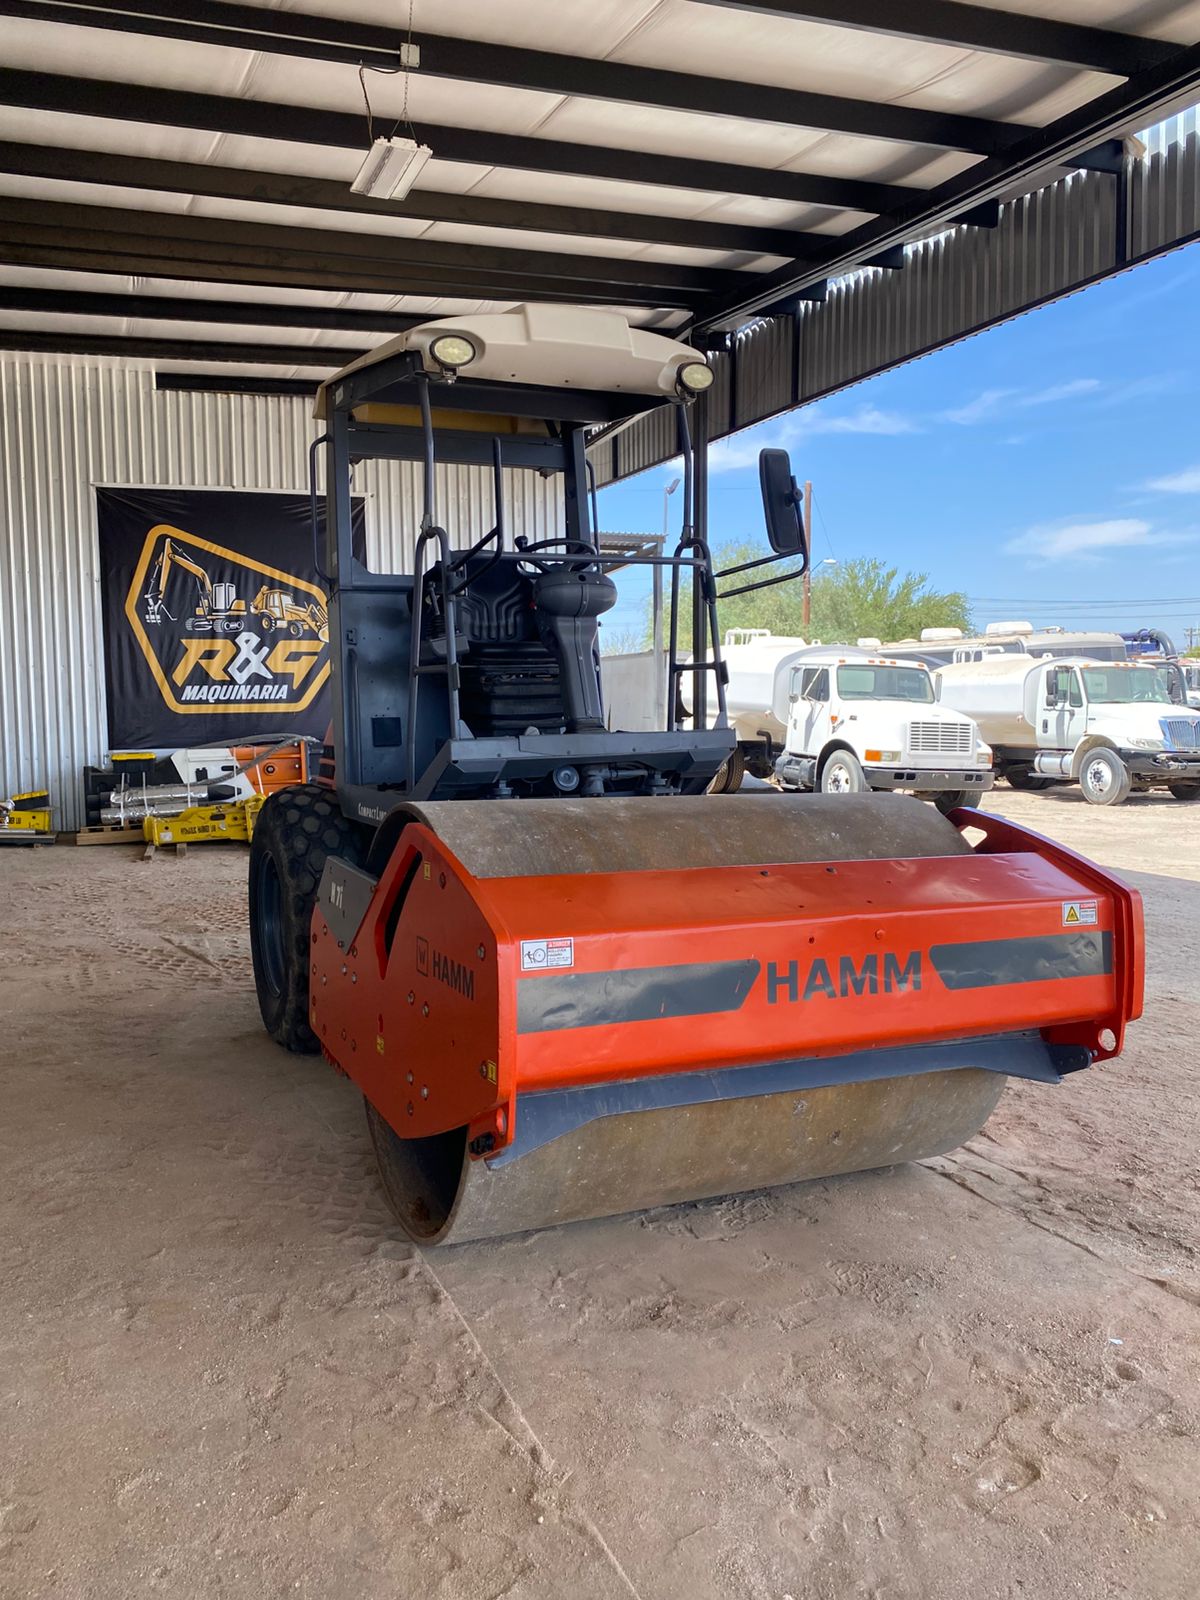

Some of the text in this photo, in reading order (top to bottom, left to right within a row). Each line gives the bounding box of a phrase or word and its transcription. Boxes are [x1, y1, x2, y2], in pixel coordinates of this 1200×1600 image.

[172, 632, 325, 690] R&G
[181, 684, 288, 703] MAQUINARIA
[432, 949, 474, 1001] HAMM
[767, 951, 922, 1004] HAMM
